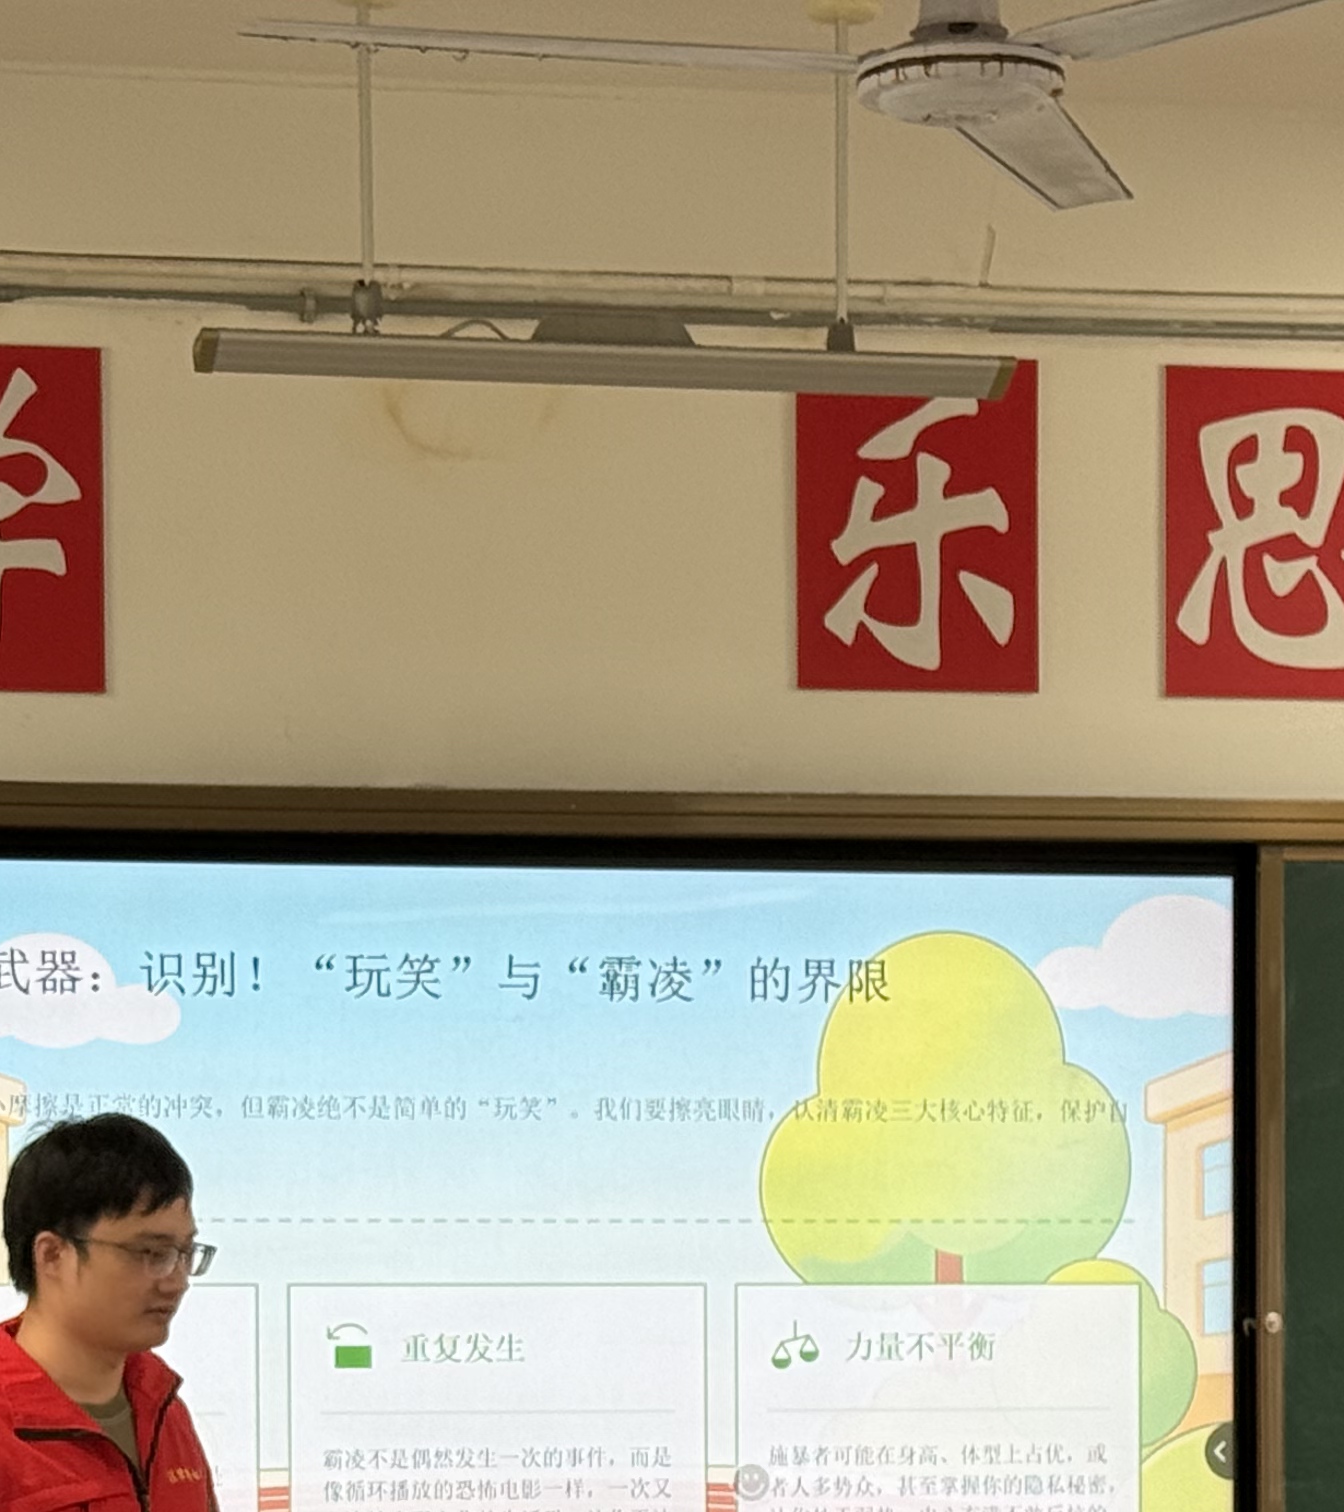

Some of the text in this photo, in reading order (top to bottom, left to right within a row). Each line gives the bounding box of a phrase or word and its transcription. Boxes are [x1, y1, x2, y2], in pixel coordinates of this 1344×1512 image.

[823, 396, 1015, 670] 乐
[402, 1333, 525, 1363] 重复发生
[845, 1331, 996, 1362] 力量不平衡
